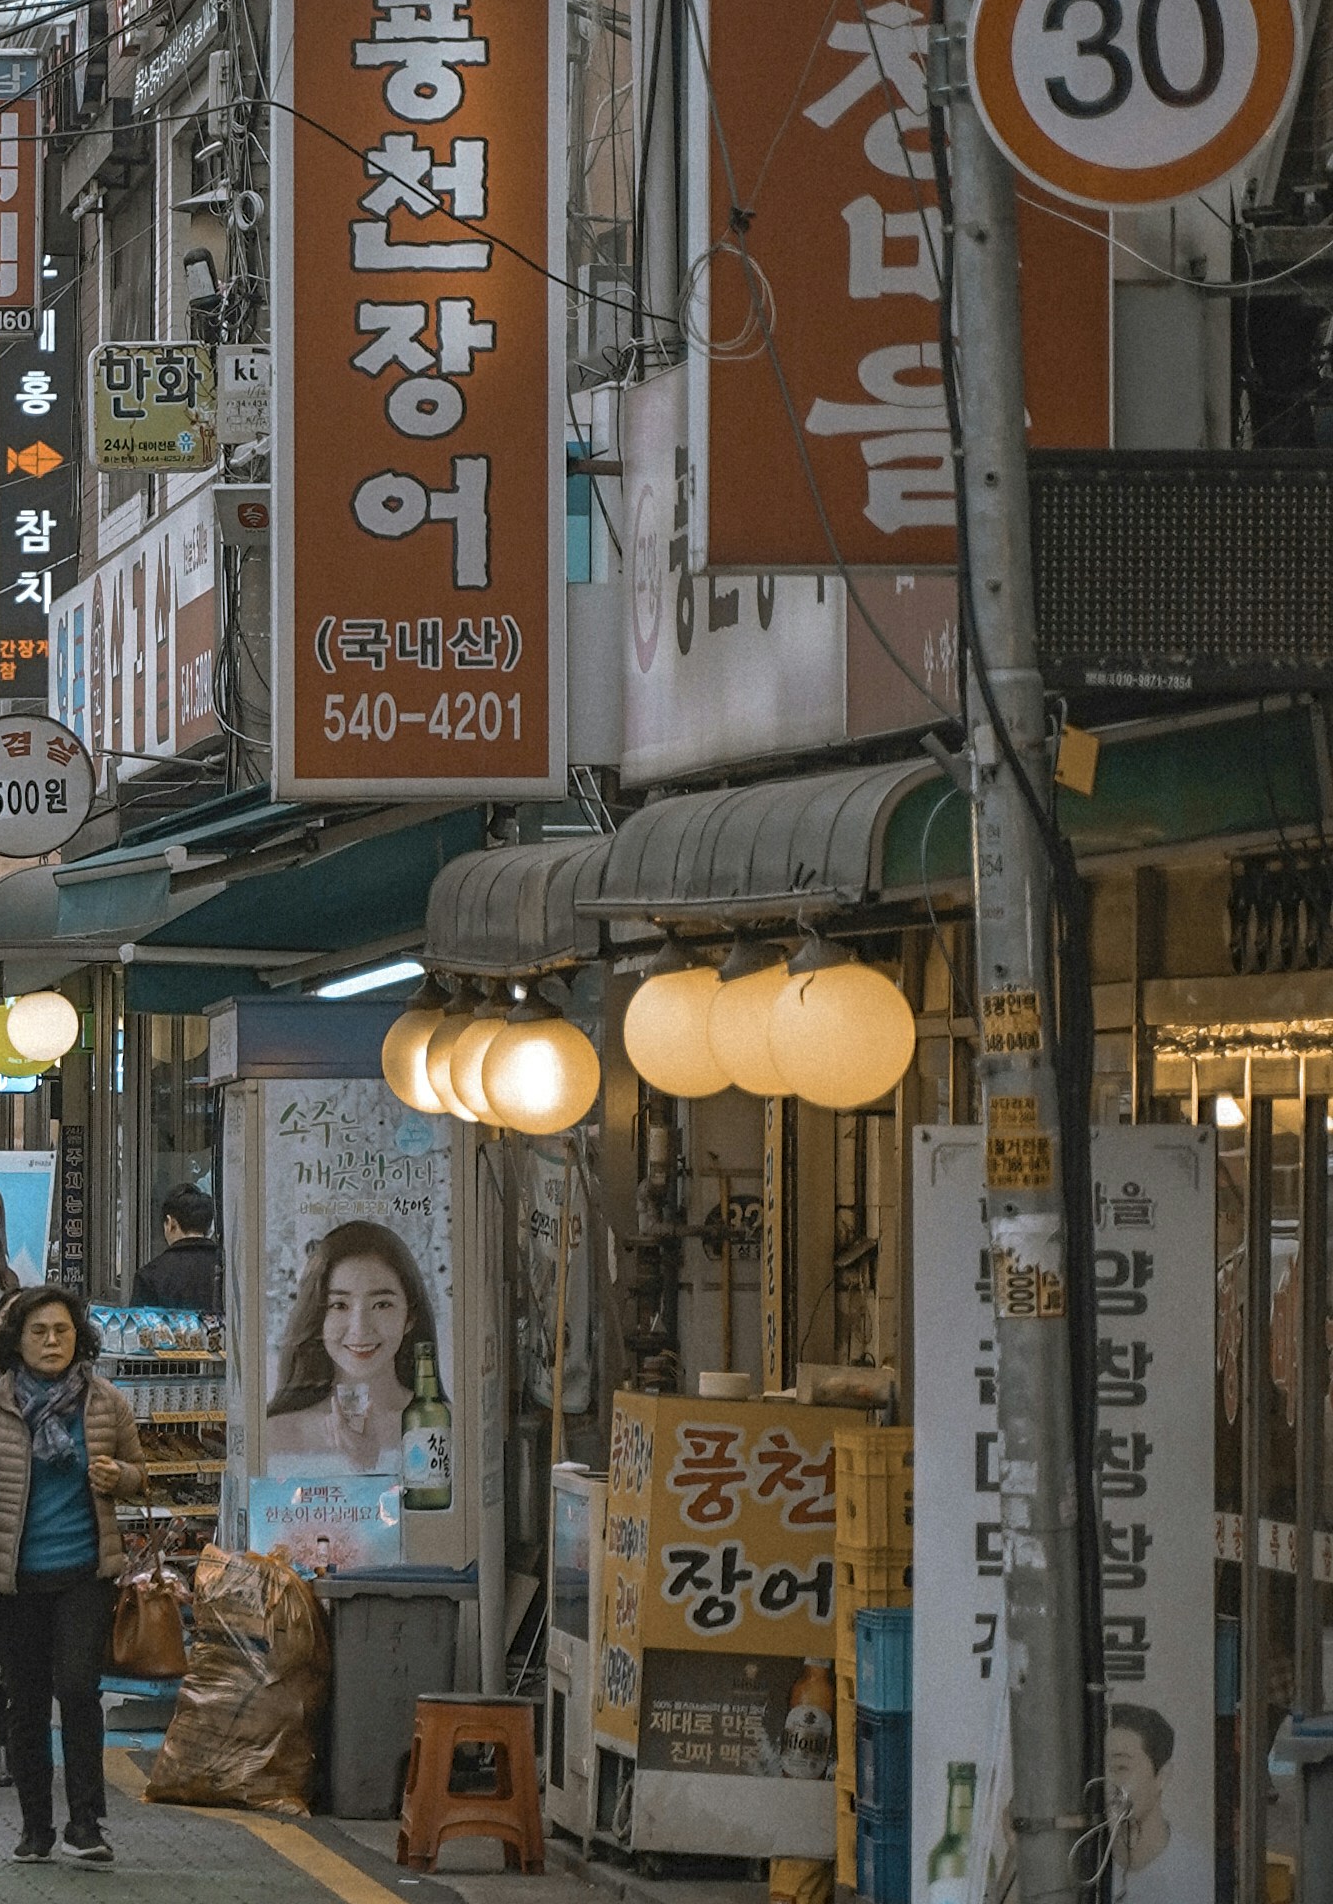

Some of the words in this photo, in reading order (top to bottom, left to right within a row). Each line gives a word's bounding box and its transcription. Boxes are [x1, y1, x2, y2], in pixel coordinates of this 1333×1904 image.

[100, 349, 202, 418] 만화
[314, 616, 523, 673] (국내산)
[323, 693, 522, 743] 540-4201
[279, 1101, 362, 1148] 소주는
[294, 1150, 435, 1191] 깨끗함이다
[393, 1196, 433, 1216] 참이슬
[674, 1426, 837, 1524] 풍천
[669, 1547, 833, 1629] 장어
